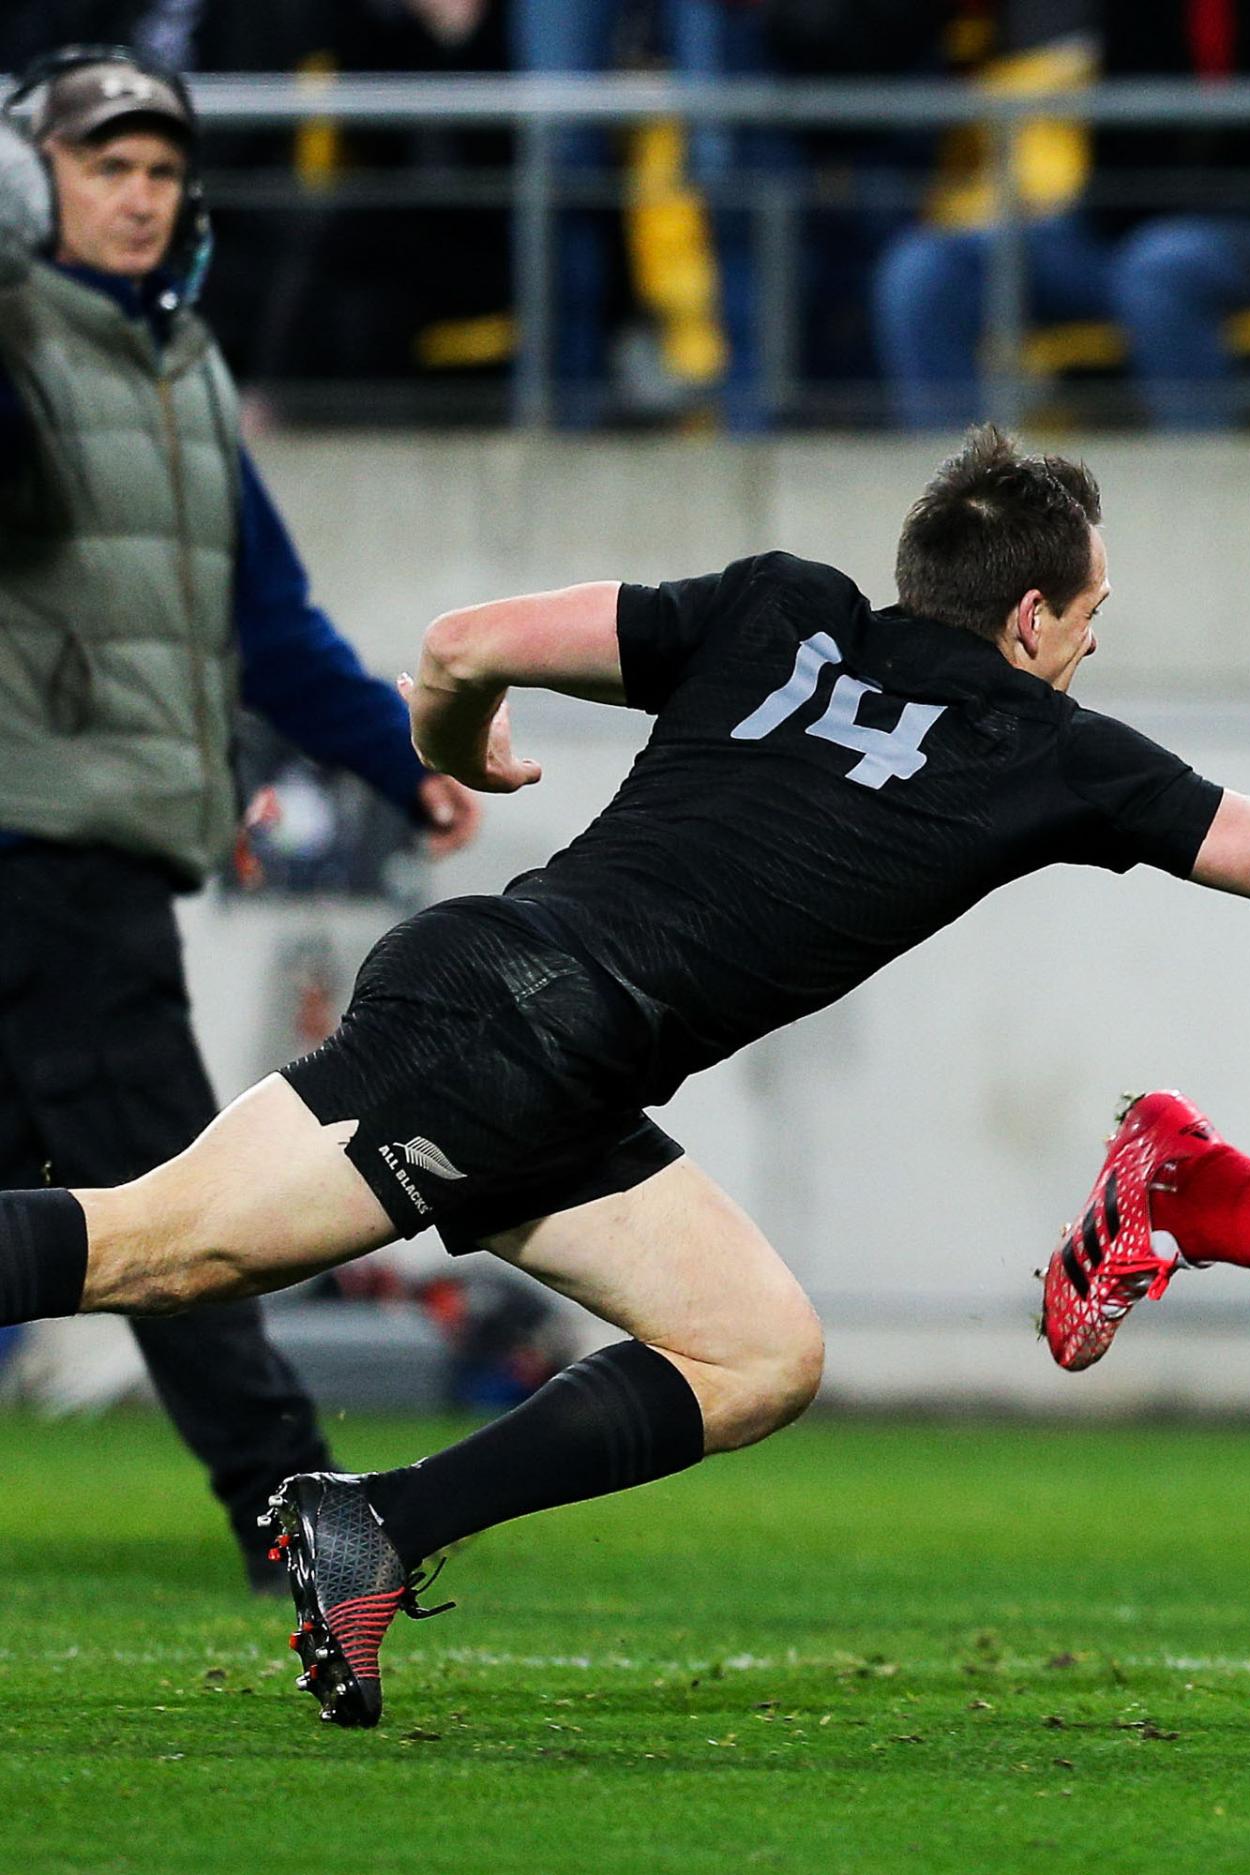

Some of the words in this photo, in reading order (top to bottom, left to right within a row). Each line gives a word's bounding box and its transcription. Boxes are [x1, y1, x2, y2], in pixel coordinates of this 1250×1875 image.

[730, 631, 948, 790] 14
[378, 1144, 398, 1170] ALL
[395, 1168, 430, 1215] BLACKS
